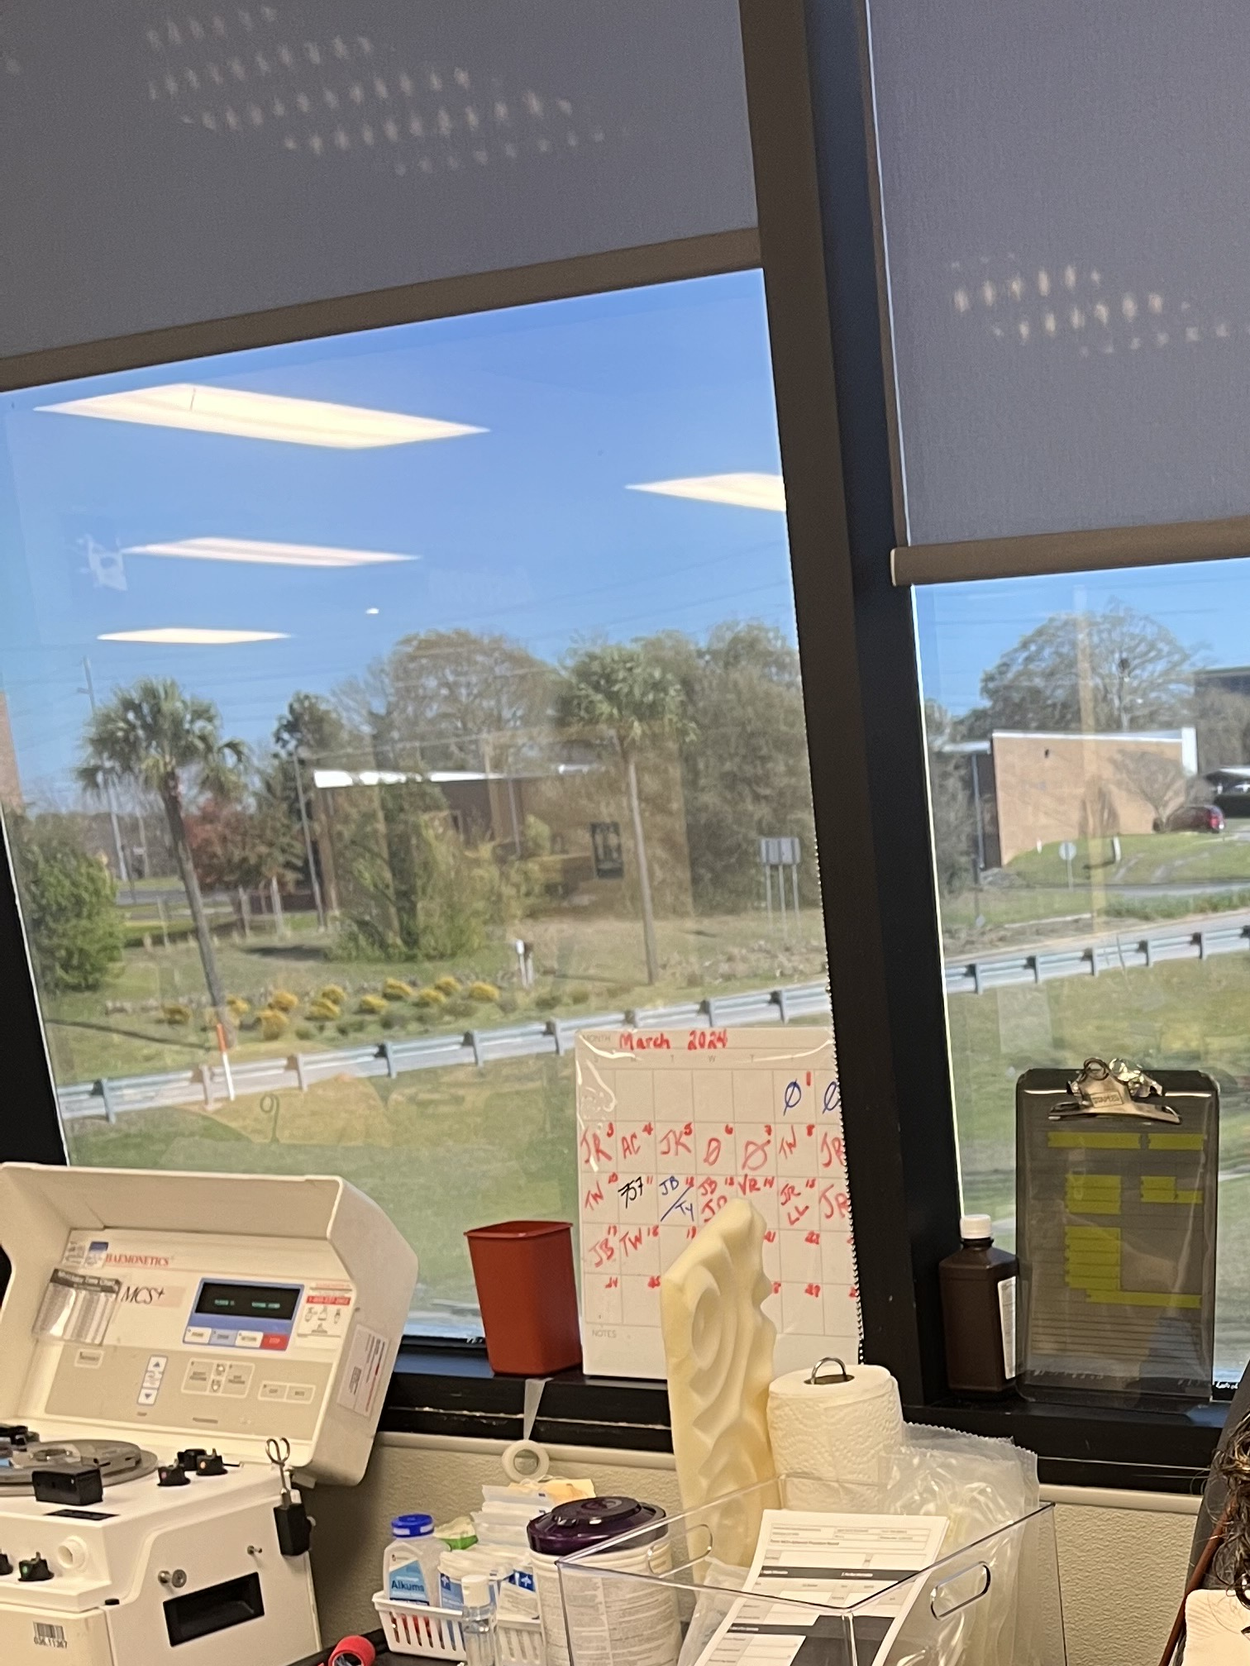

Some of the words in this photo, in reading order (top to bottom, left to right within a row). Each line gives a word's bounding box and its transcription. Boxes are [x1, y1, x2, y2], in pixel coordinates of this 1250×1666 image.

[619, 1032, 671, 1051] March
[687, 1029, 728, 1051] 2024
[621, 1132, 641, 1160] AC
